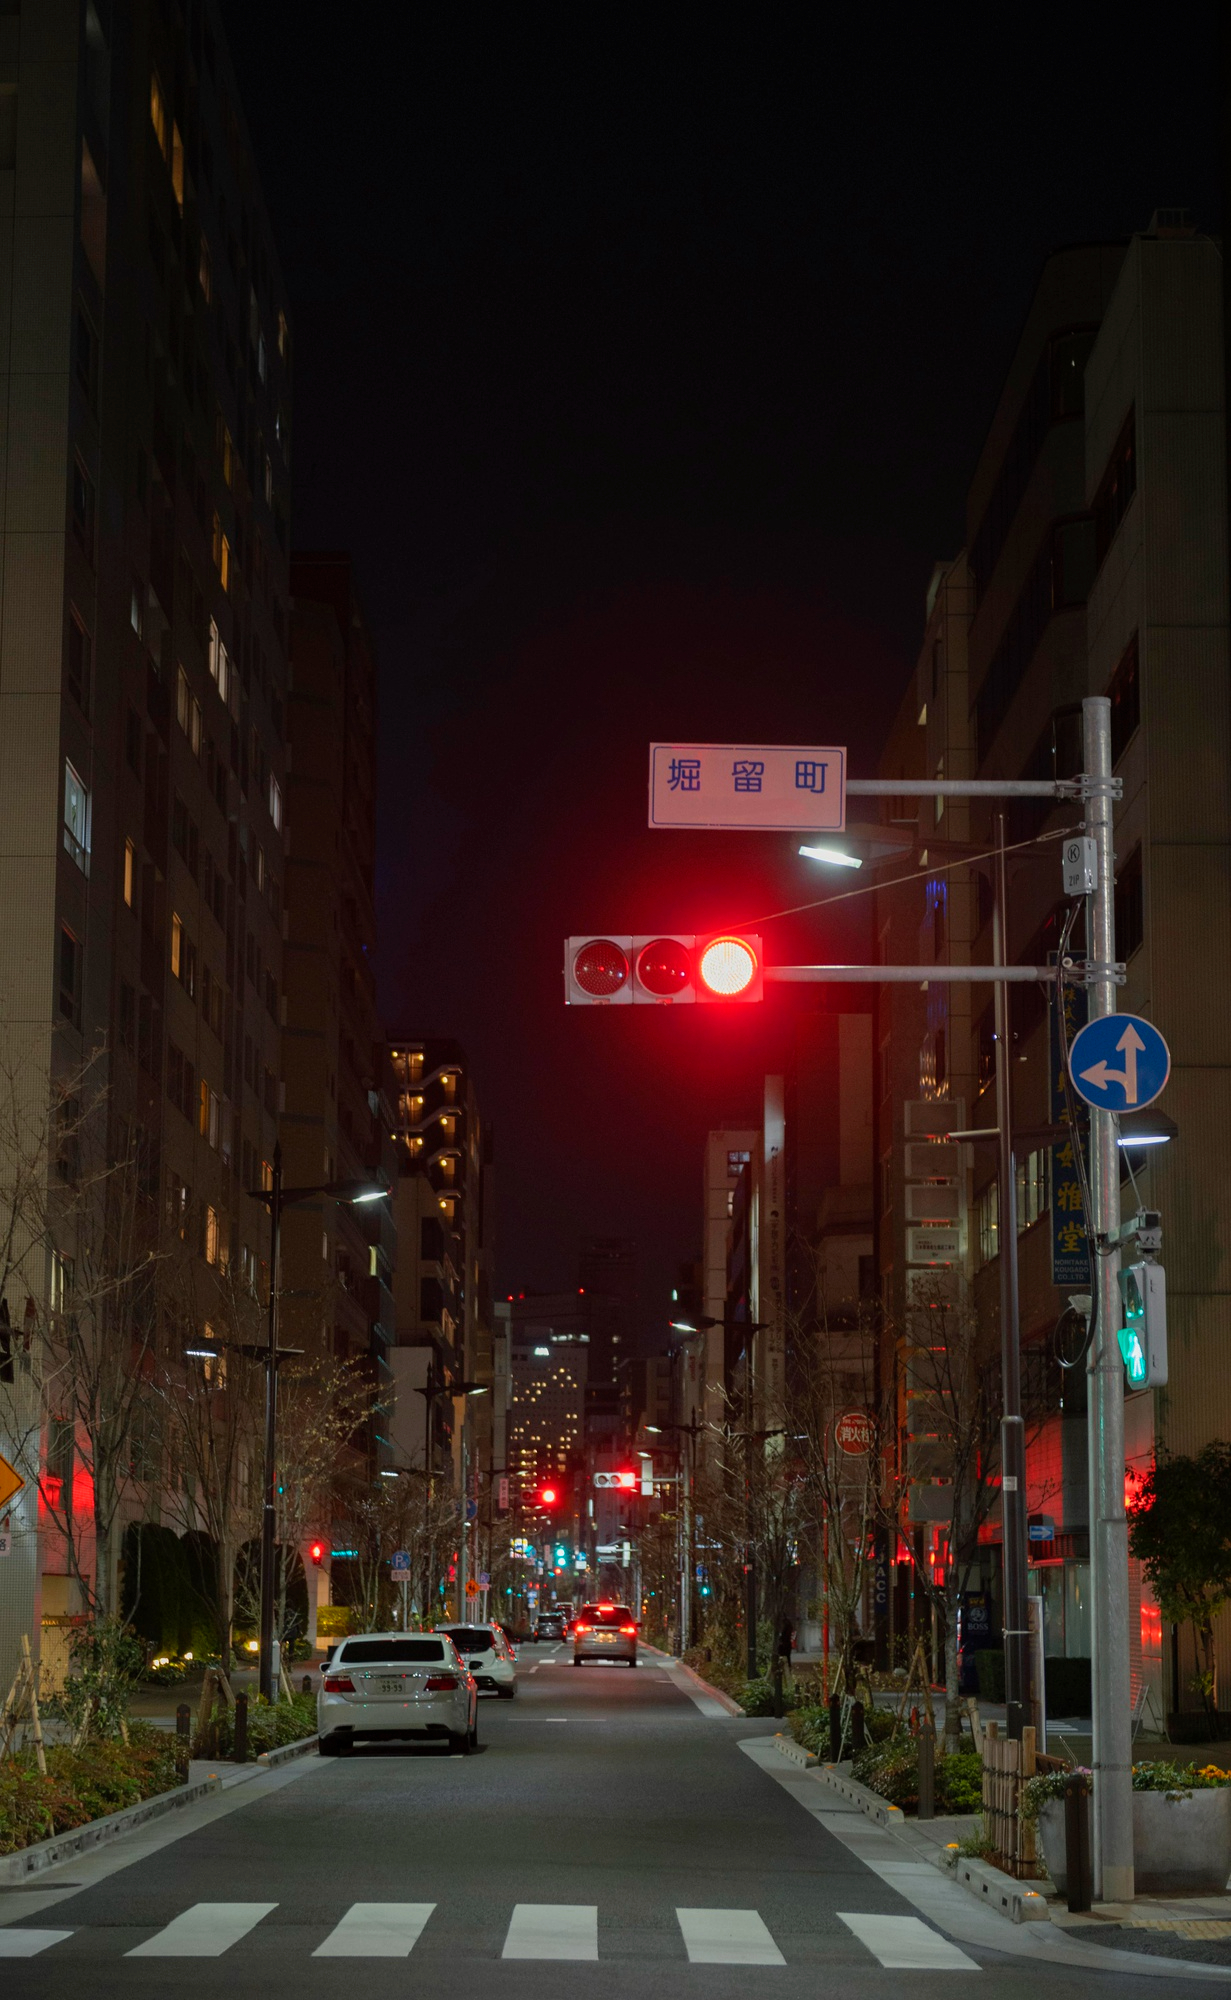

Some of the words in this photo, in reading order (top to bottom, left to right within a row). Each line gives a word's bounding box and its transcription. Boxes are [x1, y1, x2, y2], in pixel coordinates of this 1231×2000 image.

[667, 758, 829, 794] 堀留町
[967, 1622, 989, 1631] BOSS
